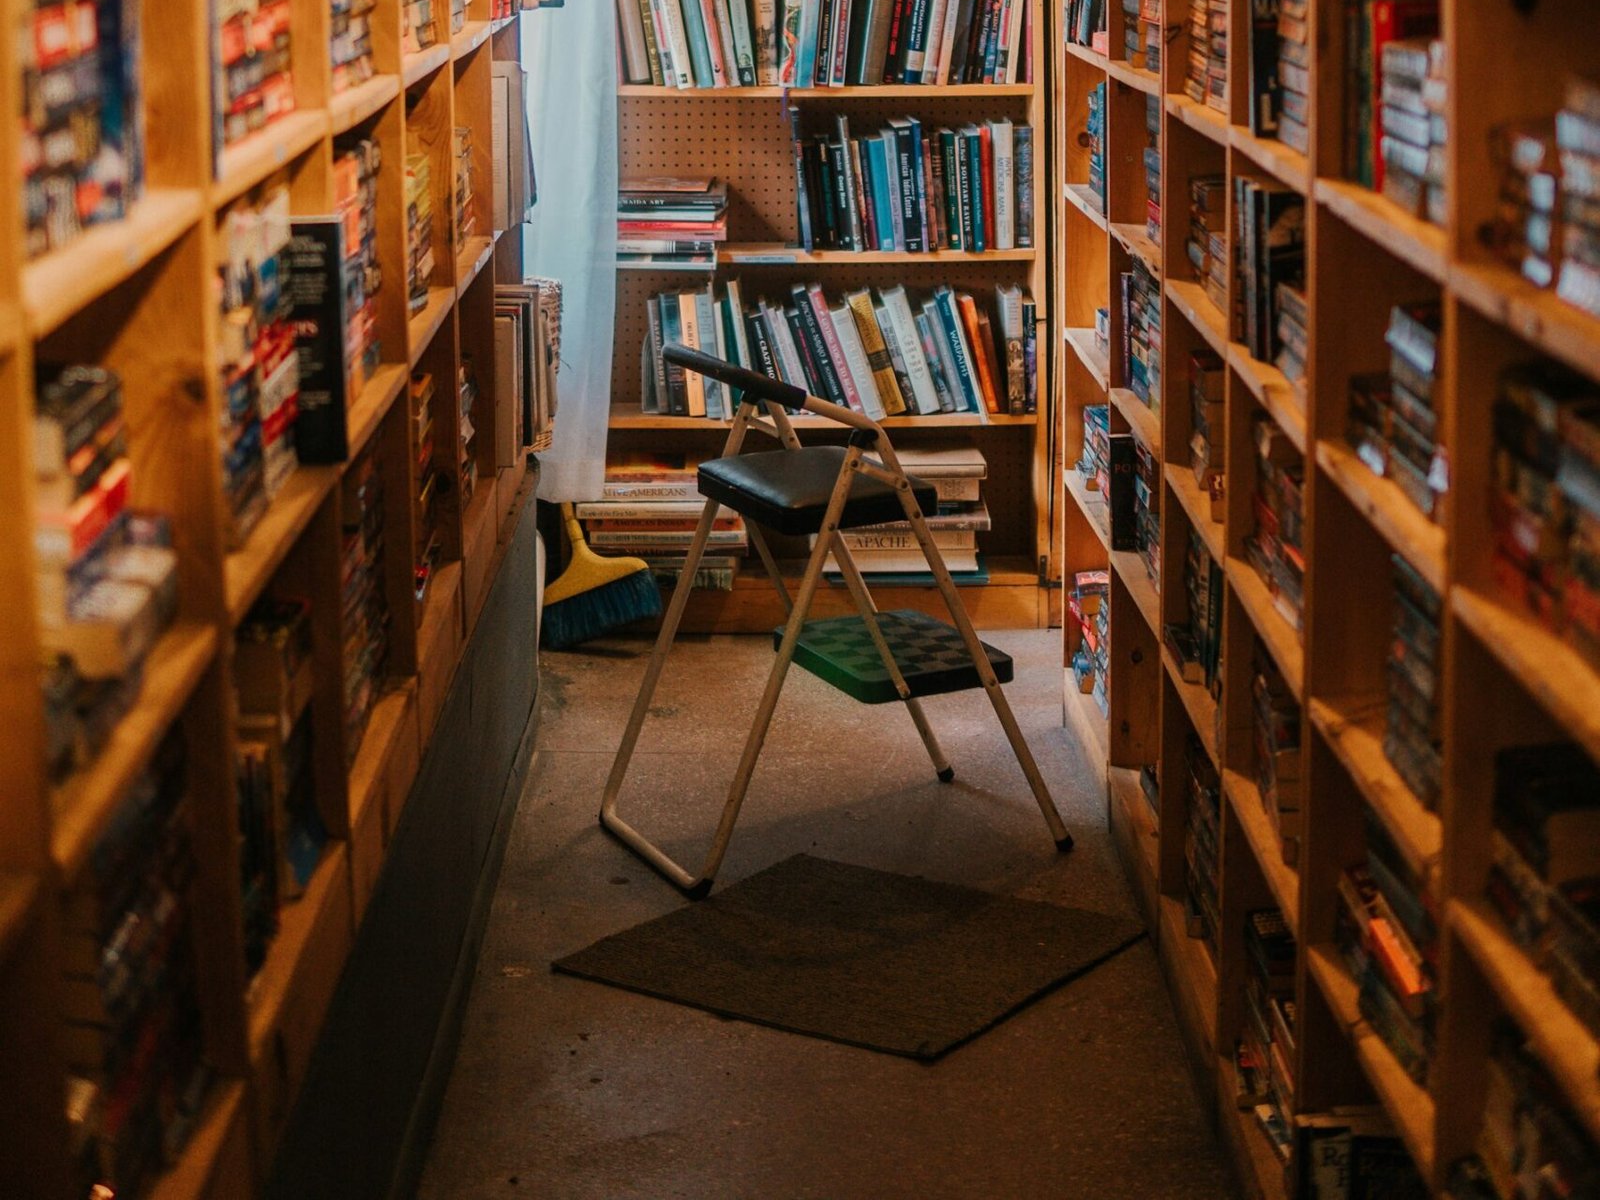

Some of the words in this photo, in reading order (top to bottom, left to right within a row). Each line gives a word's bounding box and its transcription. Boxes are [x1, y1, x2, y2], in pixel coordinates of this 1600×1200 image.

[961, 166, 969, 203] SOLITARY
[760, 340, 772, 368] CRAZY
[854, 536, 911, 549] APACHE
